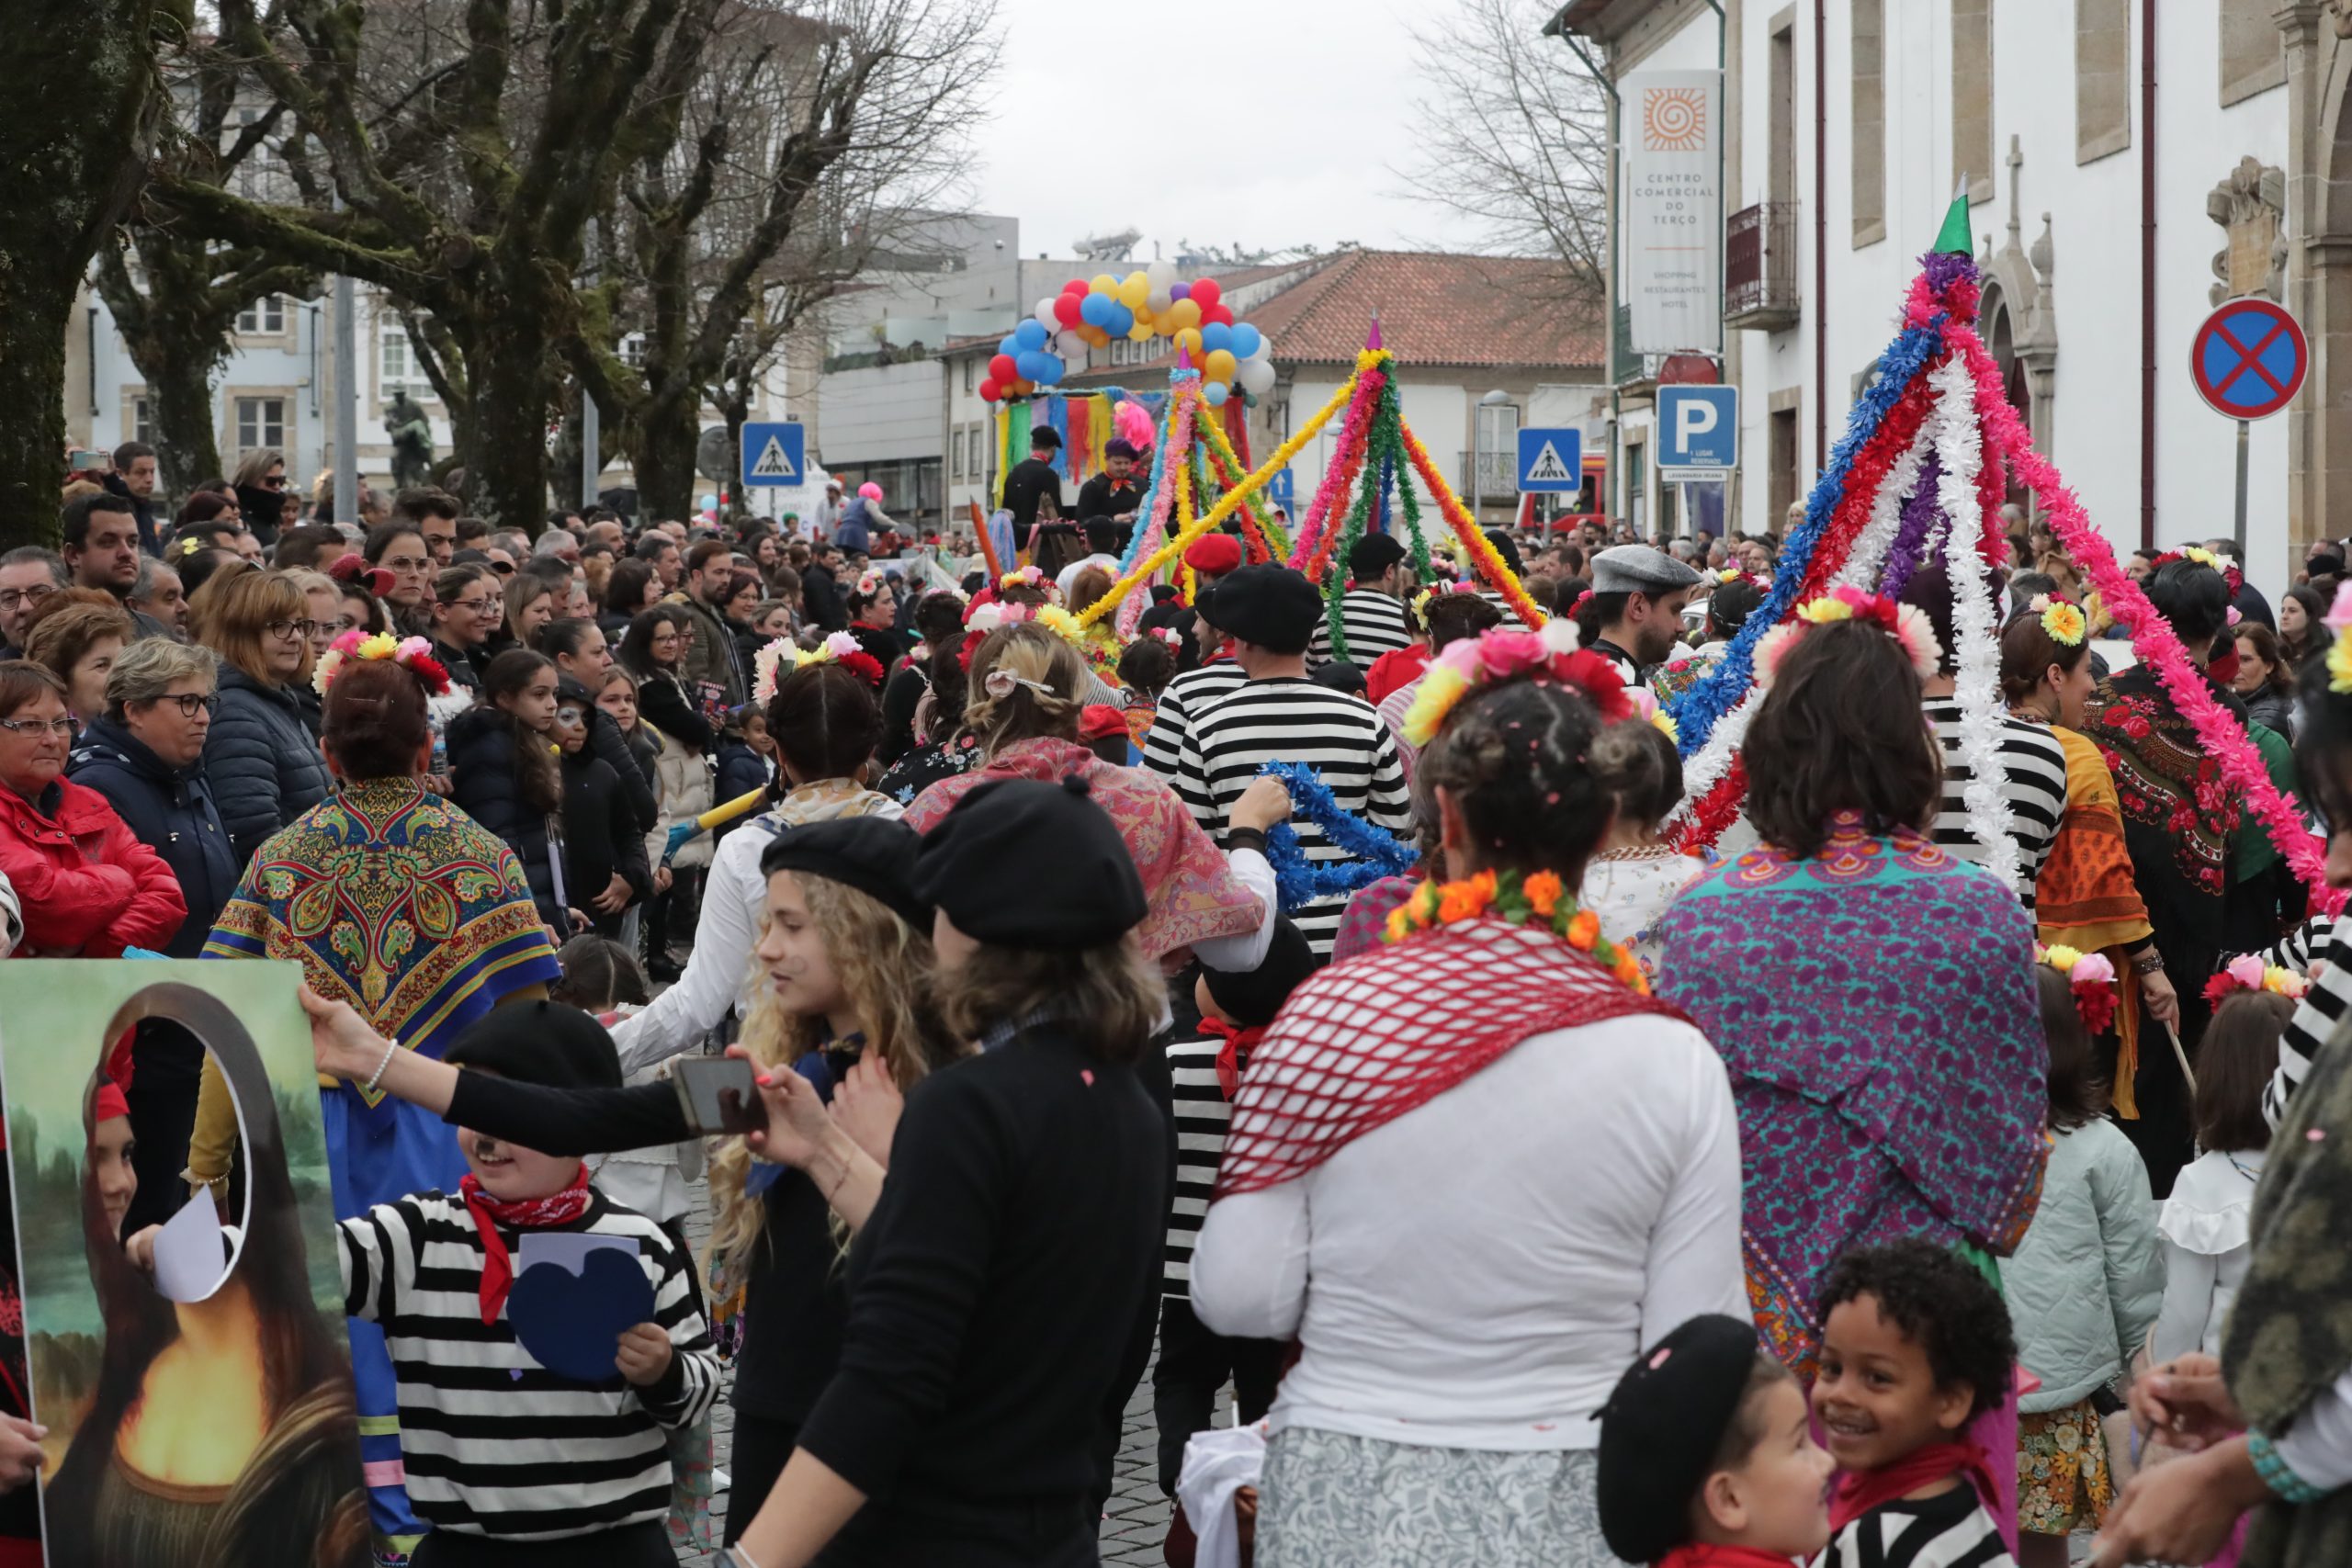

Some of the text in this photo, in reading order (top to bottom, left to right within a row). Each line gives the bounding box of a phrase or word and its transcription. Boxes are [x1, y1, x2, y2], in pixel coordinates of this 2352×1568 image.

[1647, 175, 1702, 183] CENTRO
[1635, 187, 1713, 197] COMERCIAL
[1666, 202, 1684, 210] DO
[1654, 215, 1697, 225] TERÇO
[1661, 300, 1688, 309] HOTEL
[1676, 400, 1718, 453] P
